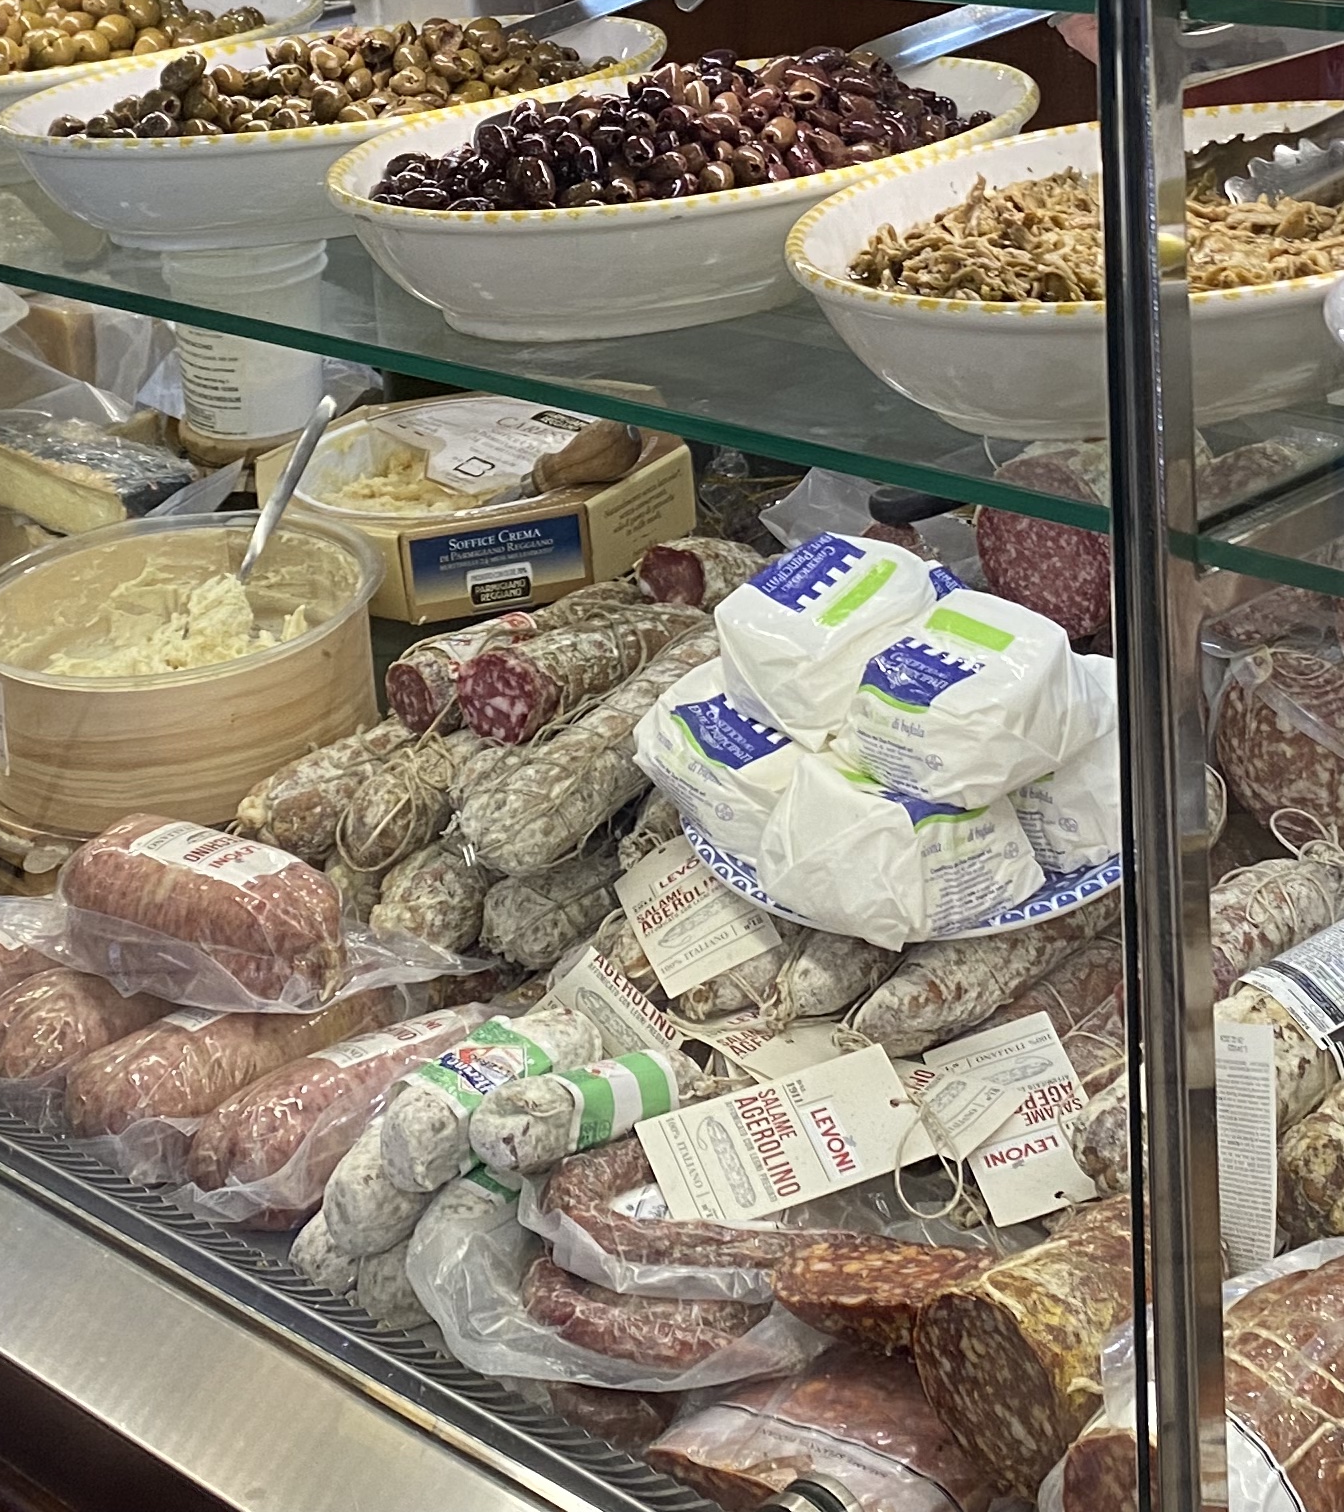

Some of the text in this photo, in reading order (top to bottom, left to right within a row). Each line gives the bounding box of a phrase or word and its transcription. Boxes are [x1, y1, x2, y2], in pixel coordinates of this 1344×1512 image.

[448, 528, 542, 551] SOFFICE CREMA
[450, 546, 506, 562] PARMIGIANO
[507, 538, 554, 552] REGGIANO
[480, 588, 523, 602] REGGIANO
[658, 857, 701, 889] LEVO
[636, 886, 685, 924] SALAME
[641, 875, 721, 934] AGEROLIN
[592, 954, 677, 1042] AGEROLINO
[726, 1011, 760, 1026] LEV
[975, 1041, 1027, 1064] ITALIANO
[785, 1081, 805, 1105] 1911
[758, 1087, 798, 1141] SALAME
[1024, 1096, 1084, 1127] SALAME
[665, 1116, 703, 1190] 100% ITALIANO
[734, 1096, 802, 1198] AGEROLINO
[809, 1106, 857, 1175] LEVONI
[983, 1134, 1060, 1169] LEVONI
